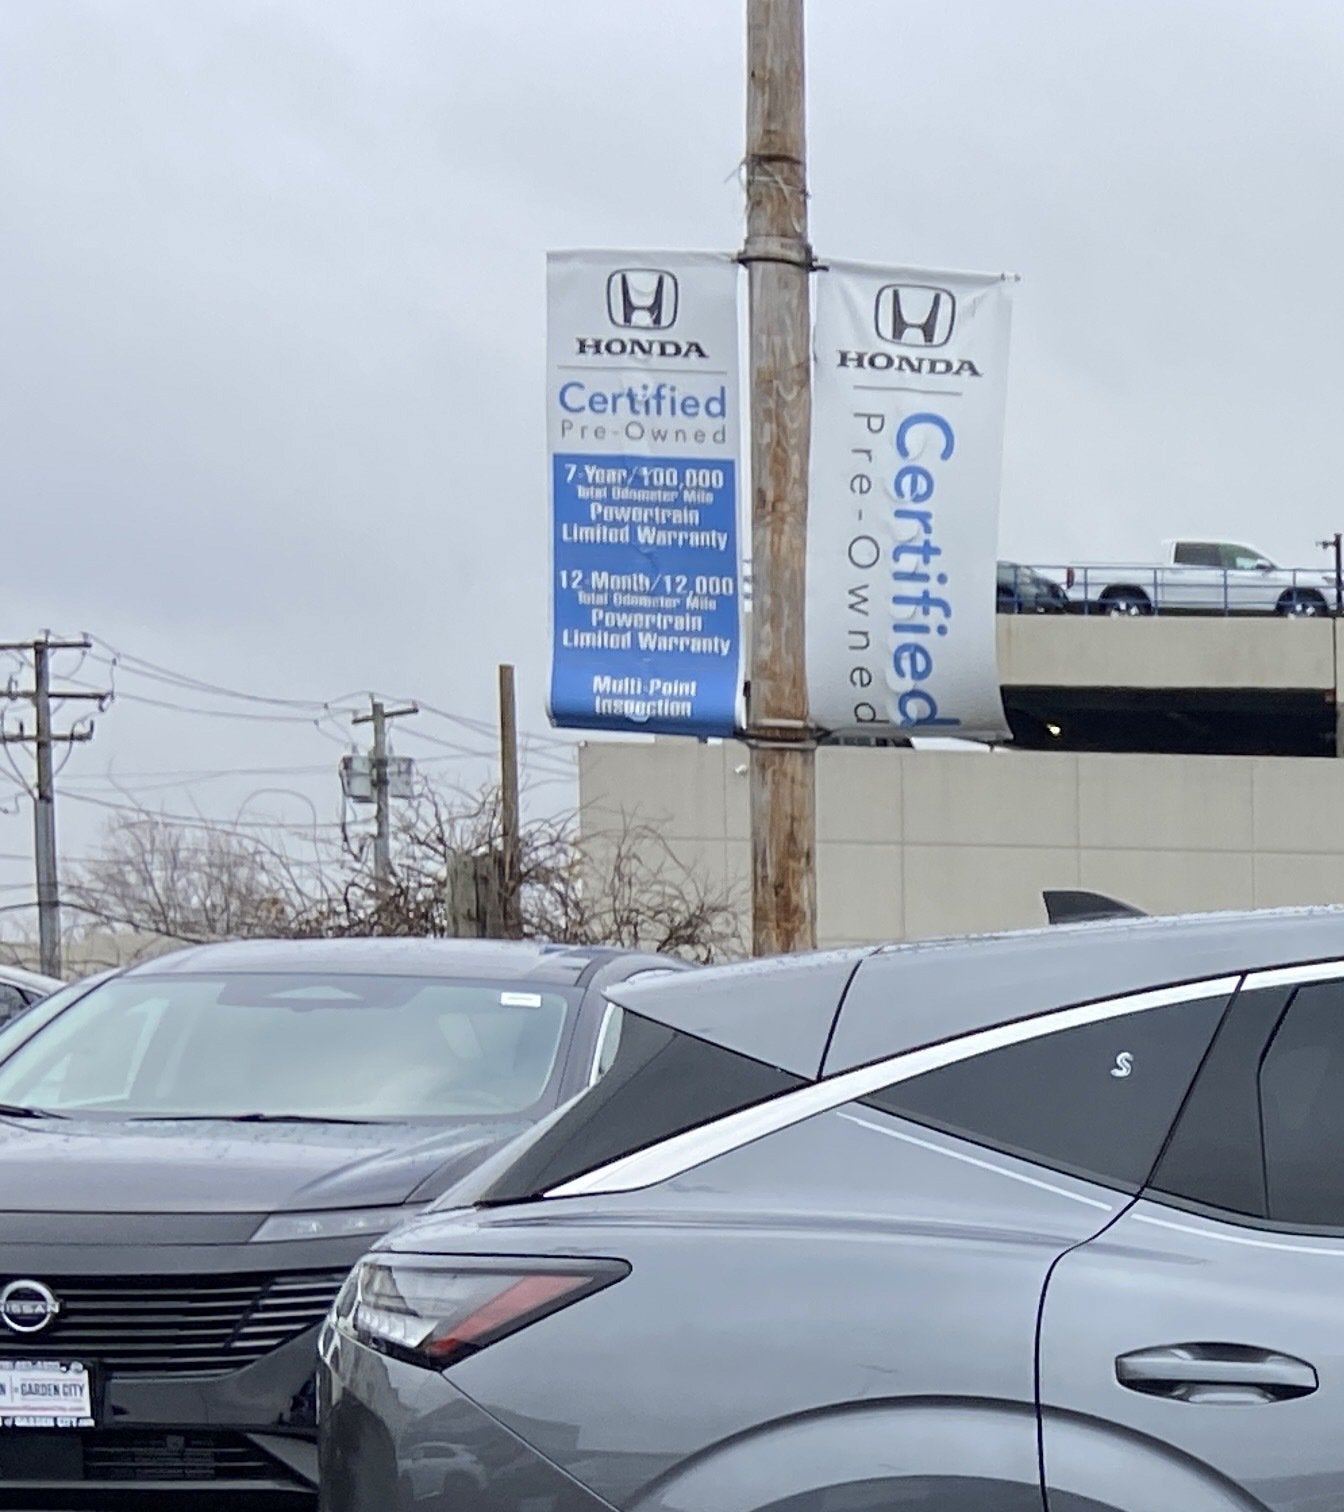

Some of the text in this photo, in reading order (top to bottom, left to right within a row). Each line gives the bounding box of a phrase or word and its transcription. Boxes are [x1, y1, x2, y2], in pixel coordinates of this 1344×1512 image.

[576, 337, 709, 358] HONDA
[836, 350, 983, 377] HONDA
[559, 381, 726, 419] Certified
[561, 419, 727, 444] Pre-Owned
[577, 485, 714, 505] Total Odometer Mile
[590, 502, 700, 526] Powertrain
[562, 523, 728, 550] Limited Warranty
[848, 412, 890, 725] Pre-Owned
[892, 412, 960, 727] Certified
[578, 591, 717, 611] Total Odometer Mile
[591, 608, 703, 632] Powertrain
[562, 629, 731, 656] Limited Warranty
[595, 696, 692, 718] Inspection
[21, 1383, 60, 1397] GARDEN
[62, 1384, 85, 1397] CITY
